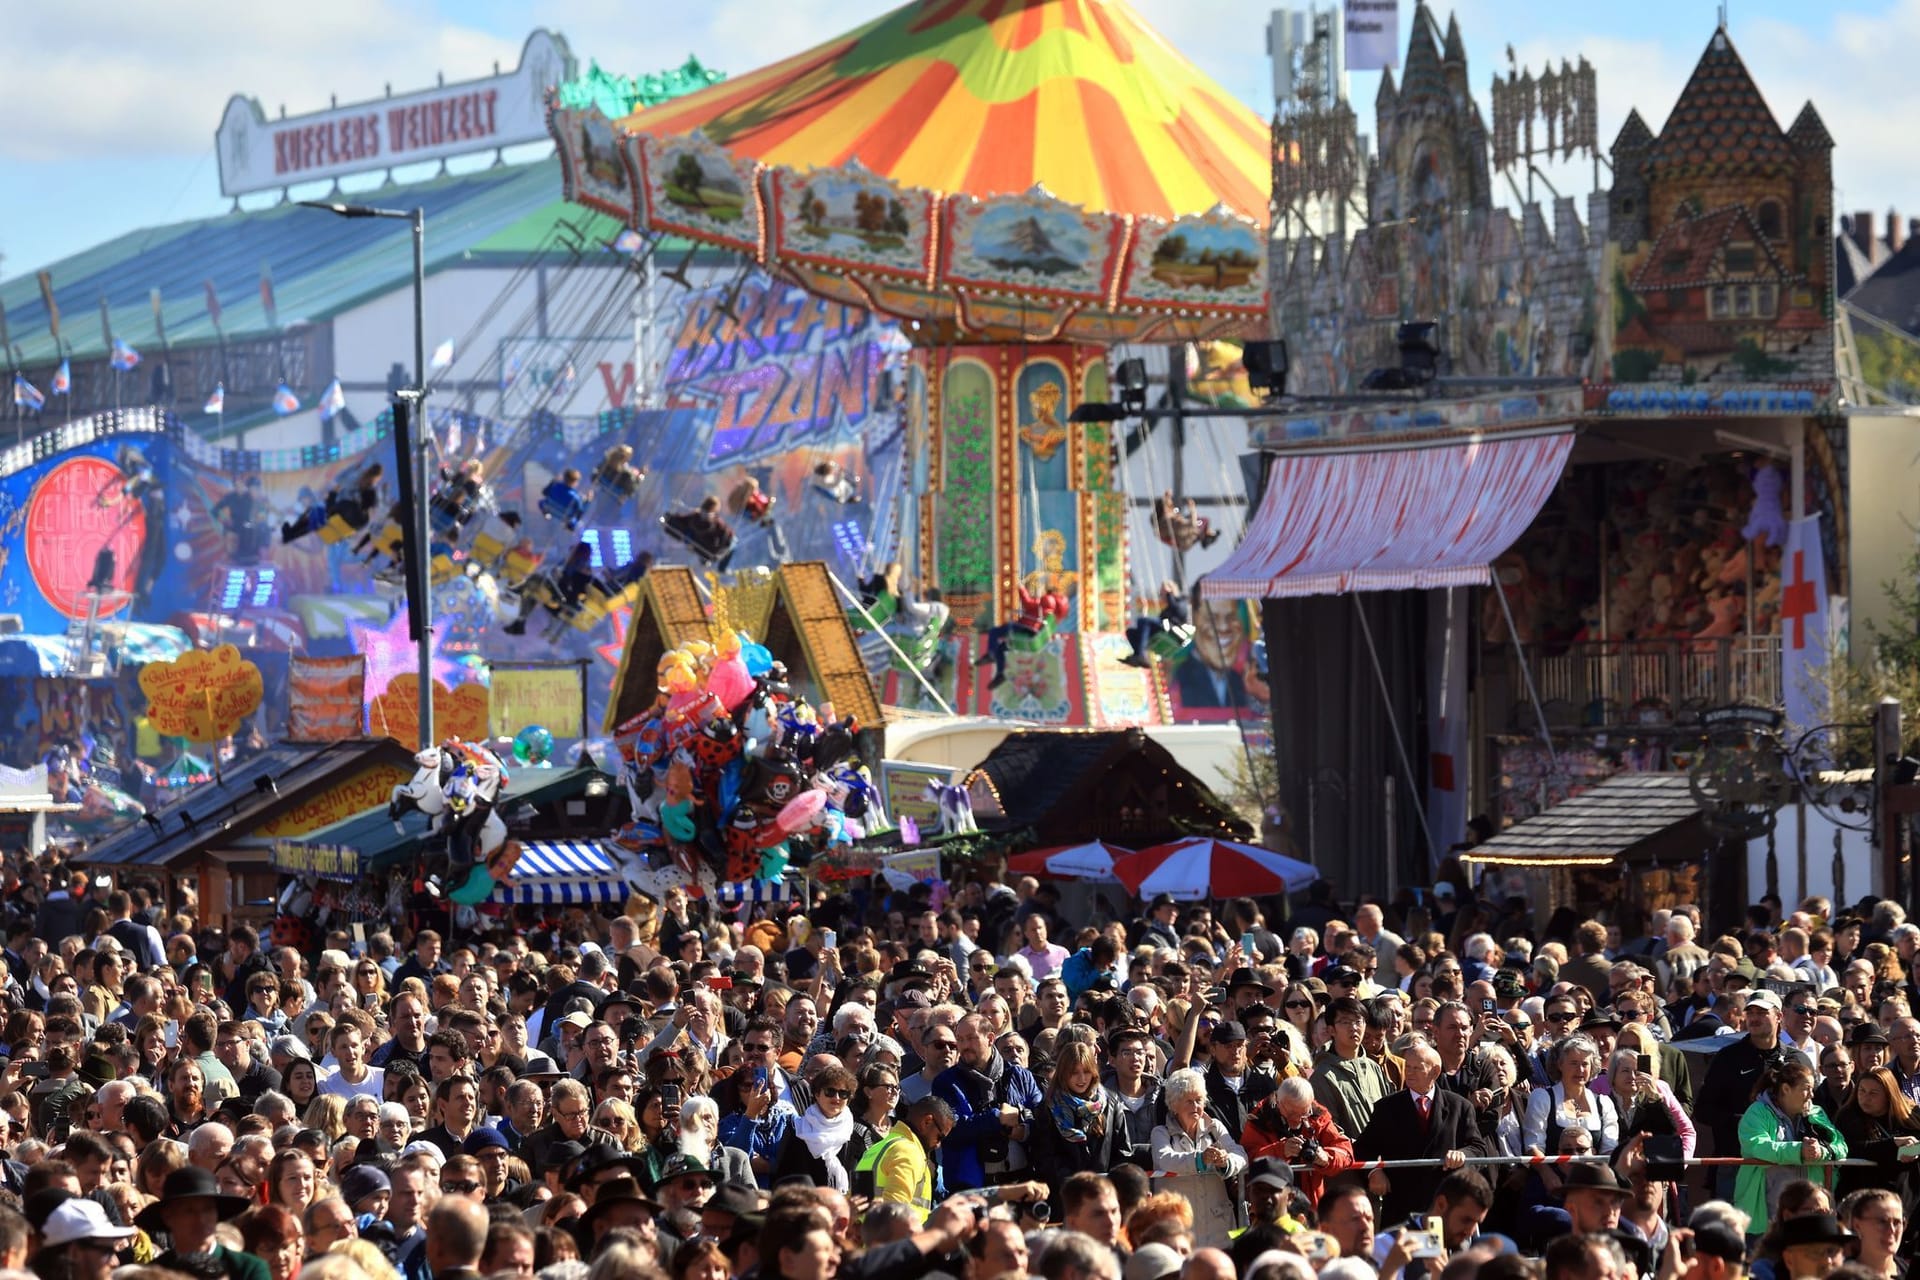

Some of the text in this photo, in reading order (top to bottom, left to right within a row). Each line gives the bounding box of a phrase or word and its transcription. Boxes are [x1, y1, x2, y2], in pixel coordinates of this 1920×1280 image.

[274, 88, 498, 176] KUFFLERS WEINZELT
[664, 272, 897, 388] BREA
